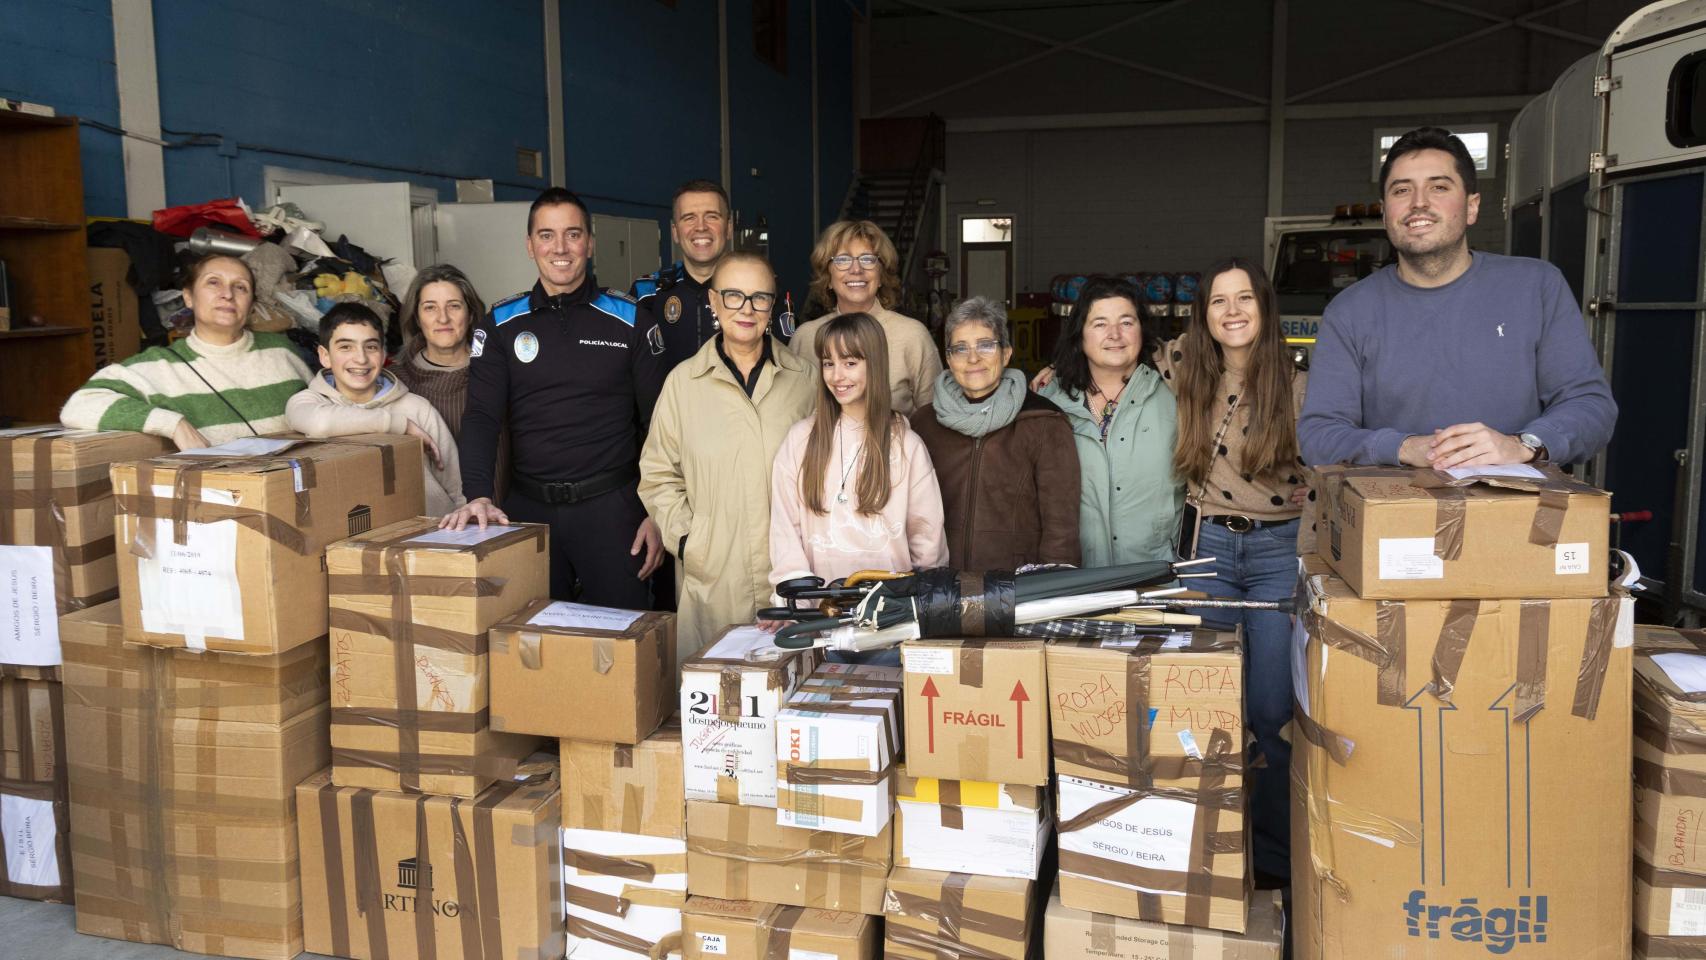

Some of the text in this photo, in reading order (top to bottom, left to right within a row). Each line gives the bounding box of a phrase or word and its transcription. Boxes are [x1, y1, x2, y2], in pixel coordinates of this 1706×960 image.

[579, 339, 629, 349] POLICÍA LOCAL
[1563, 551, 1577, 561] 15
[12, 597, 19, 608] DE
[13, 610, 21, 641] AMIGOS
[1164, 663, 1236, 700] ROPA
[1057, 673, 1118, 721] ROPA
[943, 710, 1005, 727] FRÁGIL
[1170, 705, 1241, 732] MUJER
[790, 727, 800, 762] OKI
[1125, 823, 1138, 833] DE
[1140, 826, 1173, 837] JESÚS
[1136, 851, 1166, 862] BEIRA
[702, 935, 721, 943] CAJA
[1133, 936, 1158, 945] Storage
